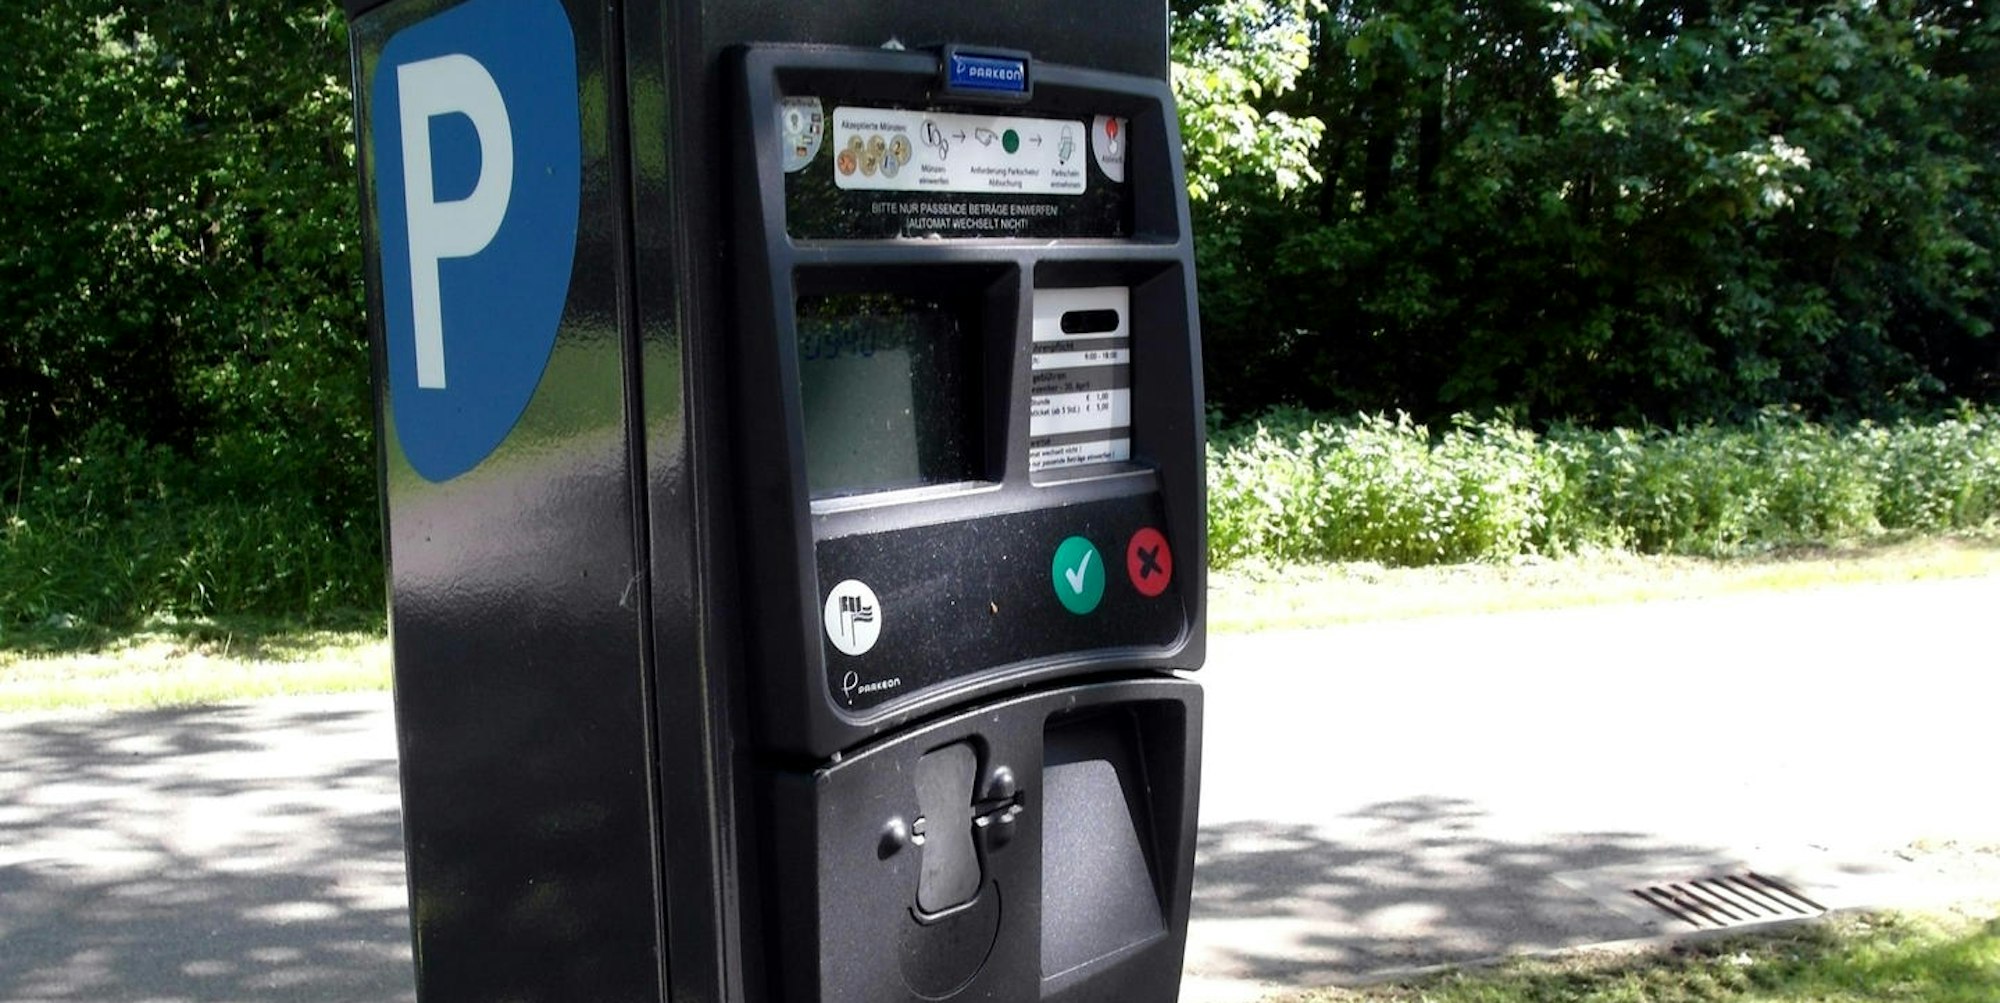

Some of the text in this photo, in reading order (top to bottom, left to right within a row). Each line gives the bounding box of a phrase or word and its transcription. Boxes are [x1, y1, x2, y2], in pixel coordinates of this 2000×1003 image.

[969, 66, 1022, 81] PARKEON
[841, 119, 878, 132] Akzeptierte
[871, 201, 1058, 216] BITTE NUR PASSENDE BETRÄGE EINWERFEN
[397, 53, 514, 389] P
[952, 217, 999, 229] WECHSELT
[858, 677, 901, 694] PARKEON
